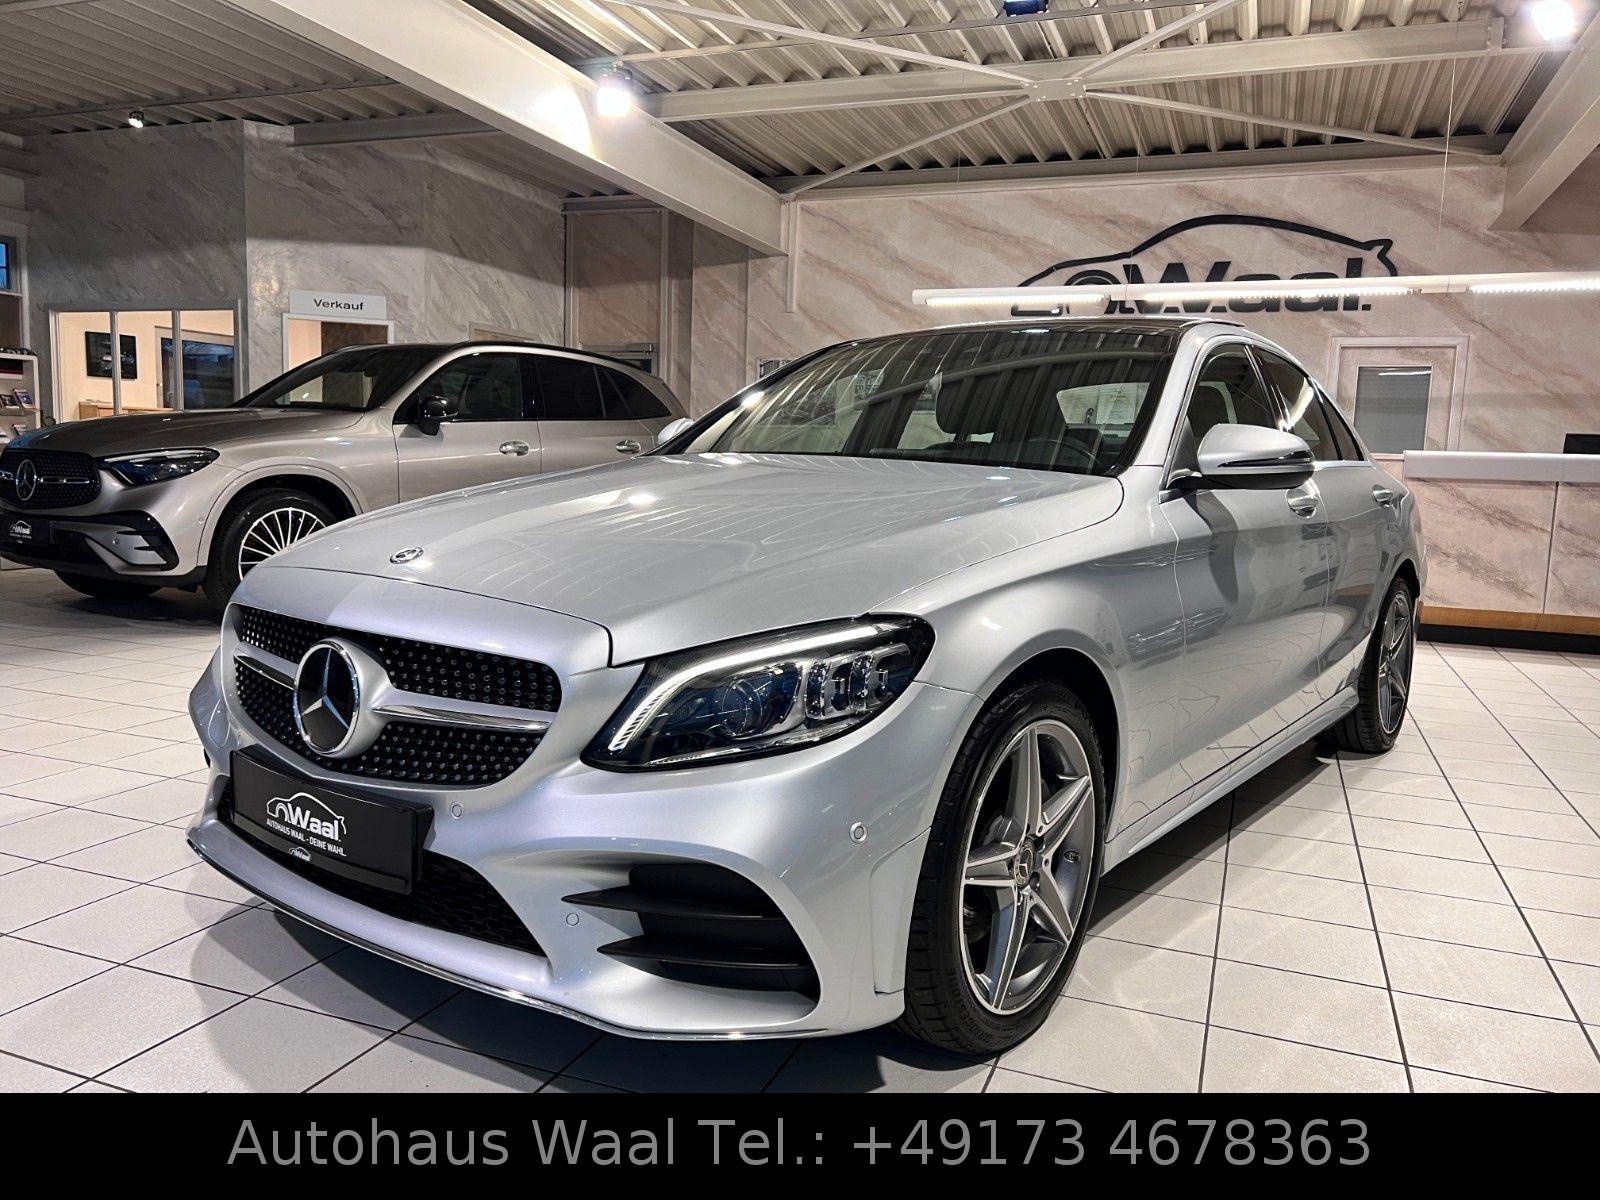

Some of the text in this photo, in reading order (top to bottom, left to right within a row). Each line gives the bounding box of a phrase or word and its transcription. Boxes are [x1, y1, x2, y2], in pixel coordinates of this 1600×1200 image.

[313, 298, 364, 311] Verkauf
[266, 818, 291, 836] AUTOHAUS
[290, 828, 306, 842] WAAL
[309, 836, 327, 850] DEINE
[945, 966, 994, 1043] BRIDGESTONE
